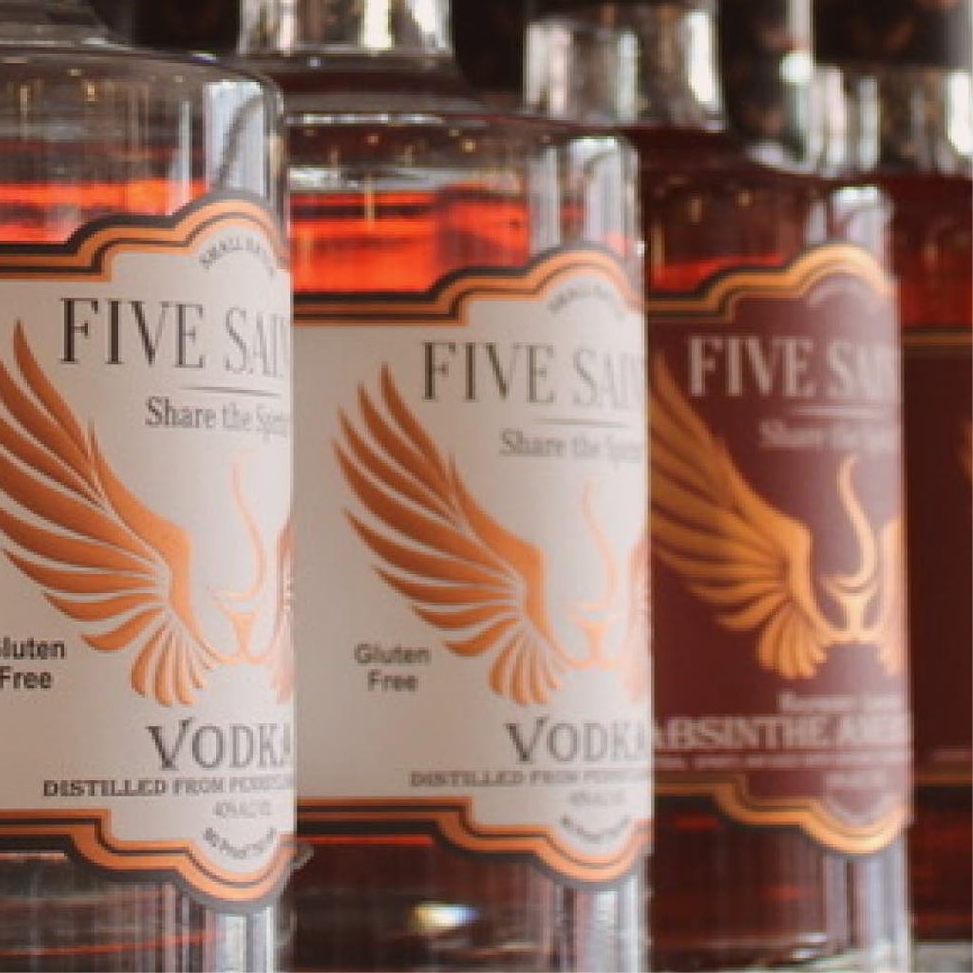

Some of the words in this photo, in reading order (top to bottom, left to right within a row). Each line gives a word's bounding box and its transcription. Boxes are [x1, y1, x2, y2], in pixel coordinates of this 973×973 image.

[59, 297, 204, 368] FIVE
[422, 341, 555, 403] FIVE
[687, 335, 815, 397] FIVE
[145, 396, 216, 428] Share
[223, 402, 251, 431] the
[499, 429, 565, 457] Share
[354, 643, 431, 665] Gluten
[367, 670, 419, 692] Free
[43, 779, 166, 797] DISTILLED
[173, 778, 224, 795] FROM
[410, 771, 524, 787] DISTILLED
